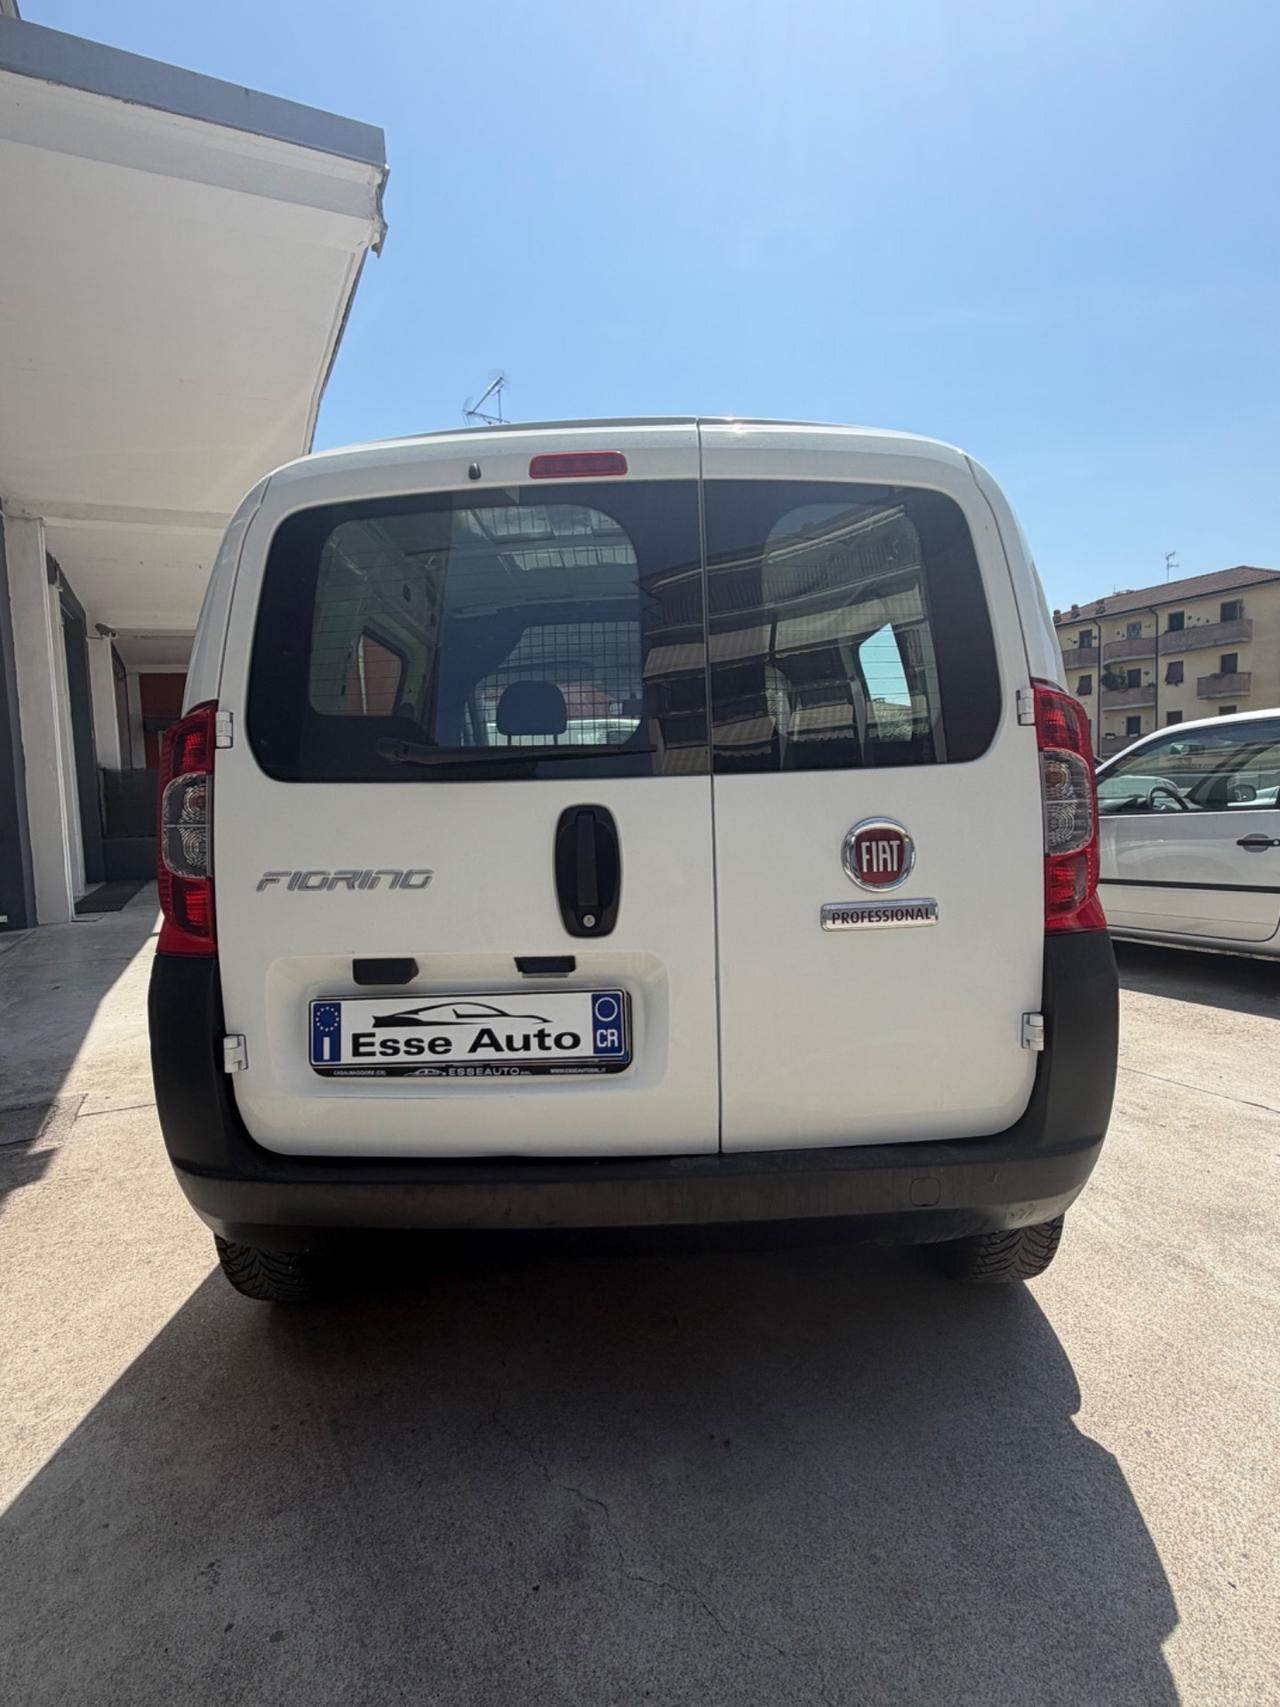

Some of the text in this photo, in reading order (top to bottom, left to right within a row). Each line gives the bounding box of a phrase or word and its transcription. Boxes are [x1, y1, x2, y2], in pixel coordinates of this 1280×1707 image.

[861, 840, 901, 873] FIAT
[255, 869, 435, 892] FIORINO
[831, 907, 932, 925] PROFESSIONAL
[351, 1028, 581, 1058] Esse Auto
[596, 1029, 618, 1048] CR
[448, 1067, 520, 1076] ESSEAUTO
